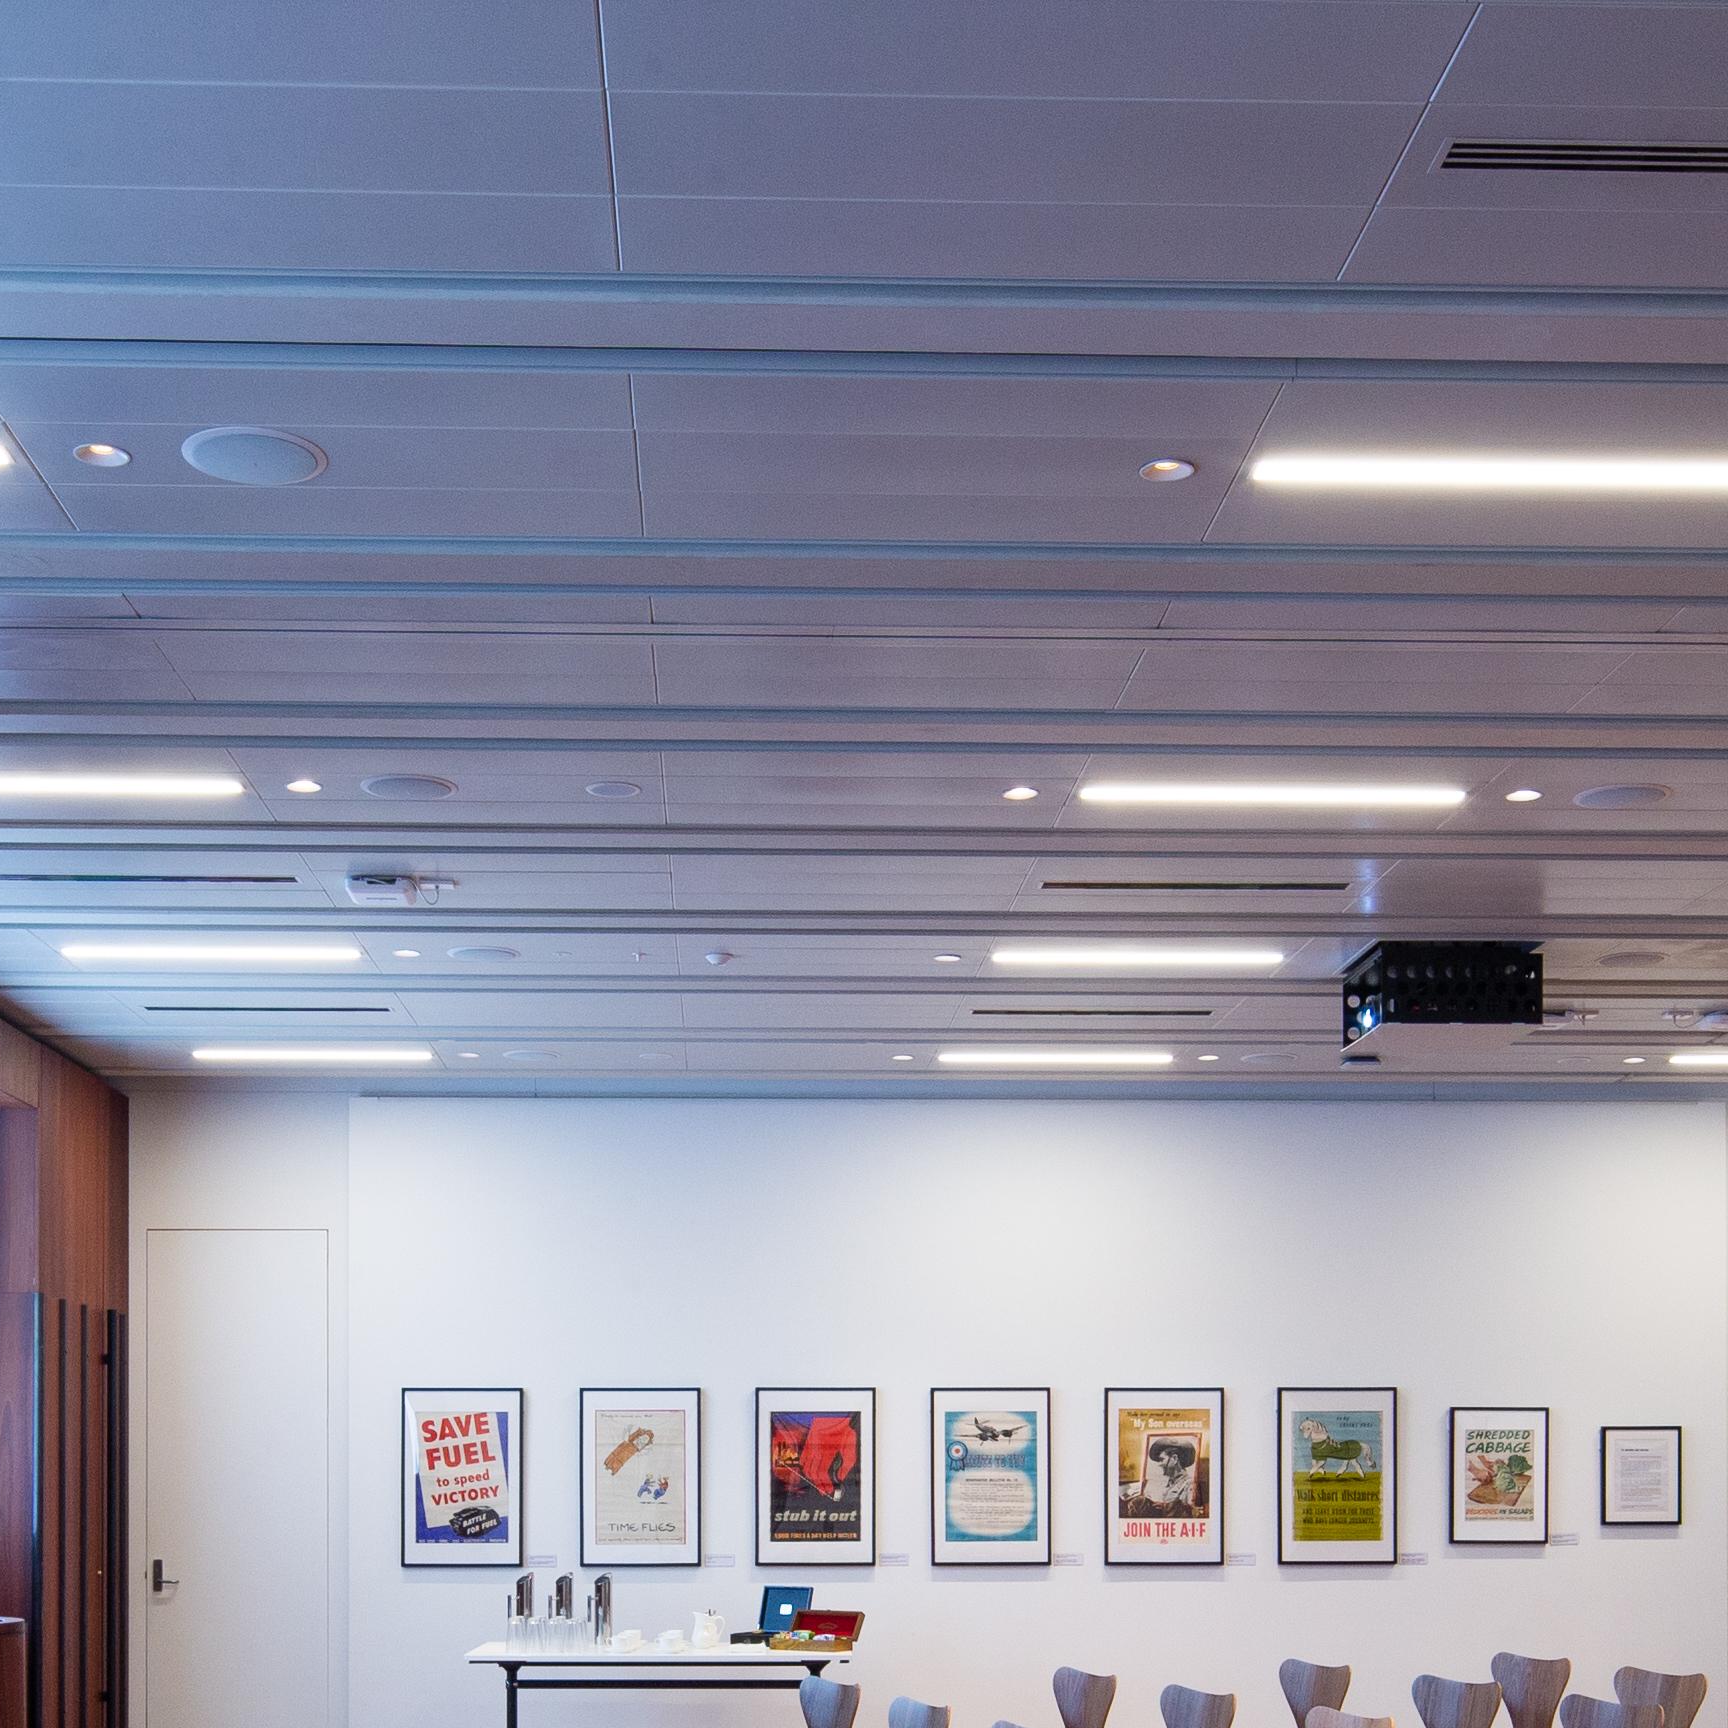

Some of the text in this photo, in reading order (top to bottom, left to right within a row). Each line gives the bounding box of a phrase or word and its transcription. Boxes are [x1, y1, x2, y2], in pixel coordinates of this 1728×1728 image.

[421, 1412, 490, 1443] SAVE
[1148, 1418, 1164, 1428] Son
[1467, 1430, 1531, 1441] SHREDDED
[425, 1440, 496, 1471] FUEL
[1465, 1442, 1531, 1454] CABBAGE
[436, 1469, 490, 1487] to speed
[431, 1485, 500, 1506] VICTORY
[1297, 1489, 1316, 1502] Walk
[1317, 1489, 1338, 1502] short
[462, 1513, 487, 1528] BATTLE
[774, 1509, 857, 1522] stub it out
[467, 1519, 498, 1535] FOR FUEL
[608, 1522, 676, 1533] TIME FLIES
[1124, 1522, 1151, 1538] JOIN
[1155, 1522, 1176, 1538] THE
